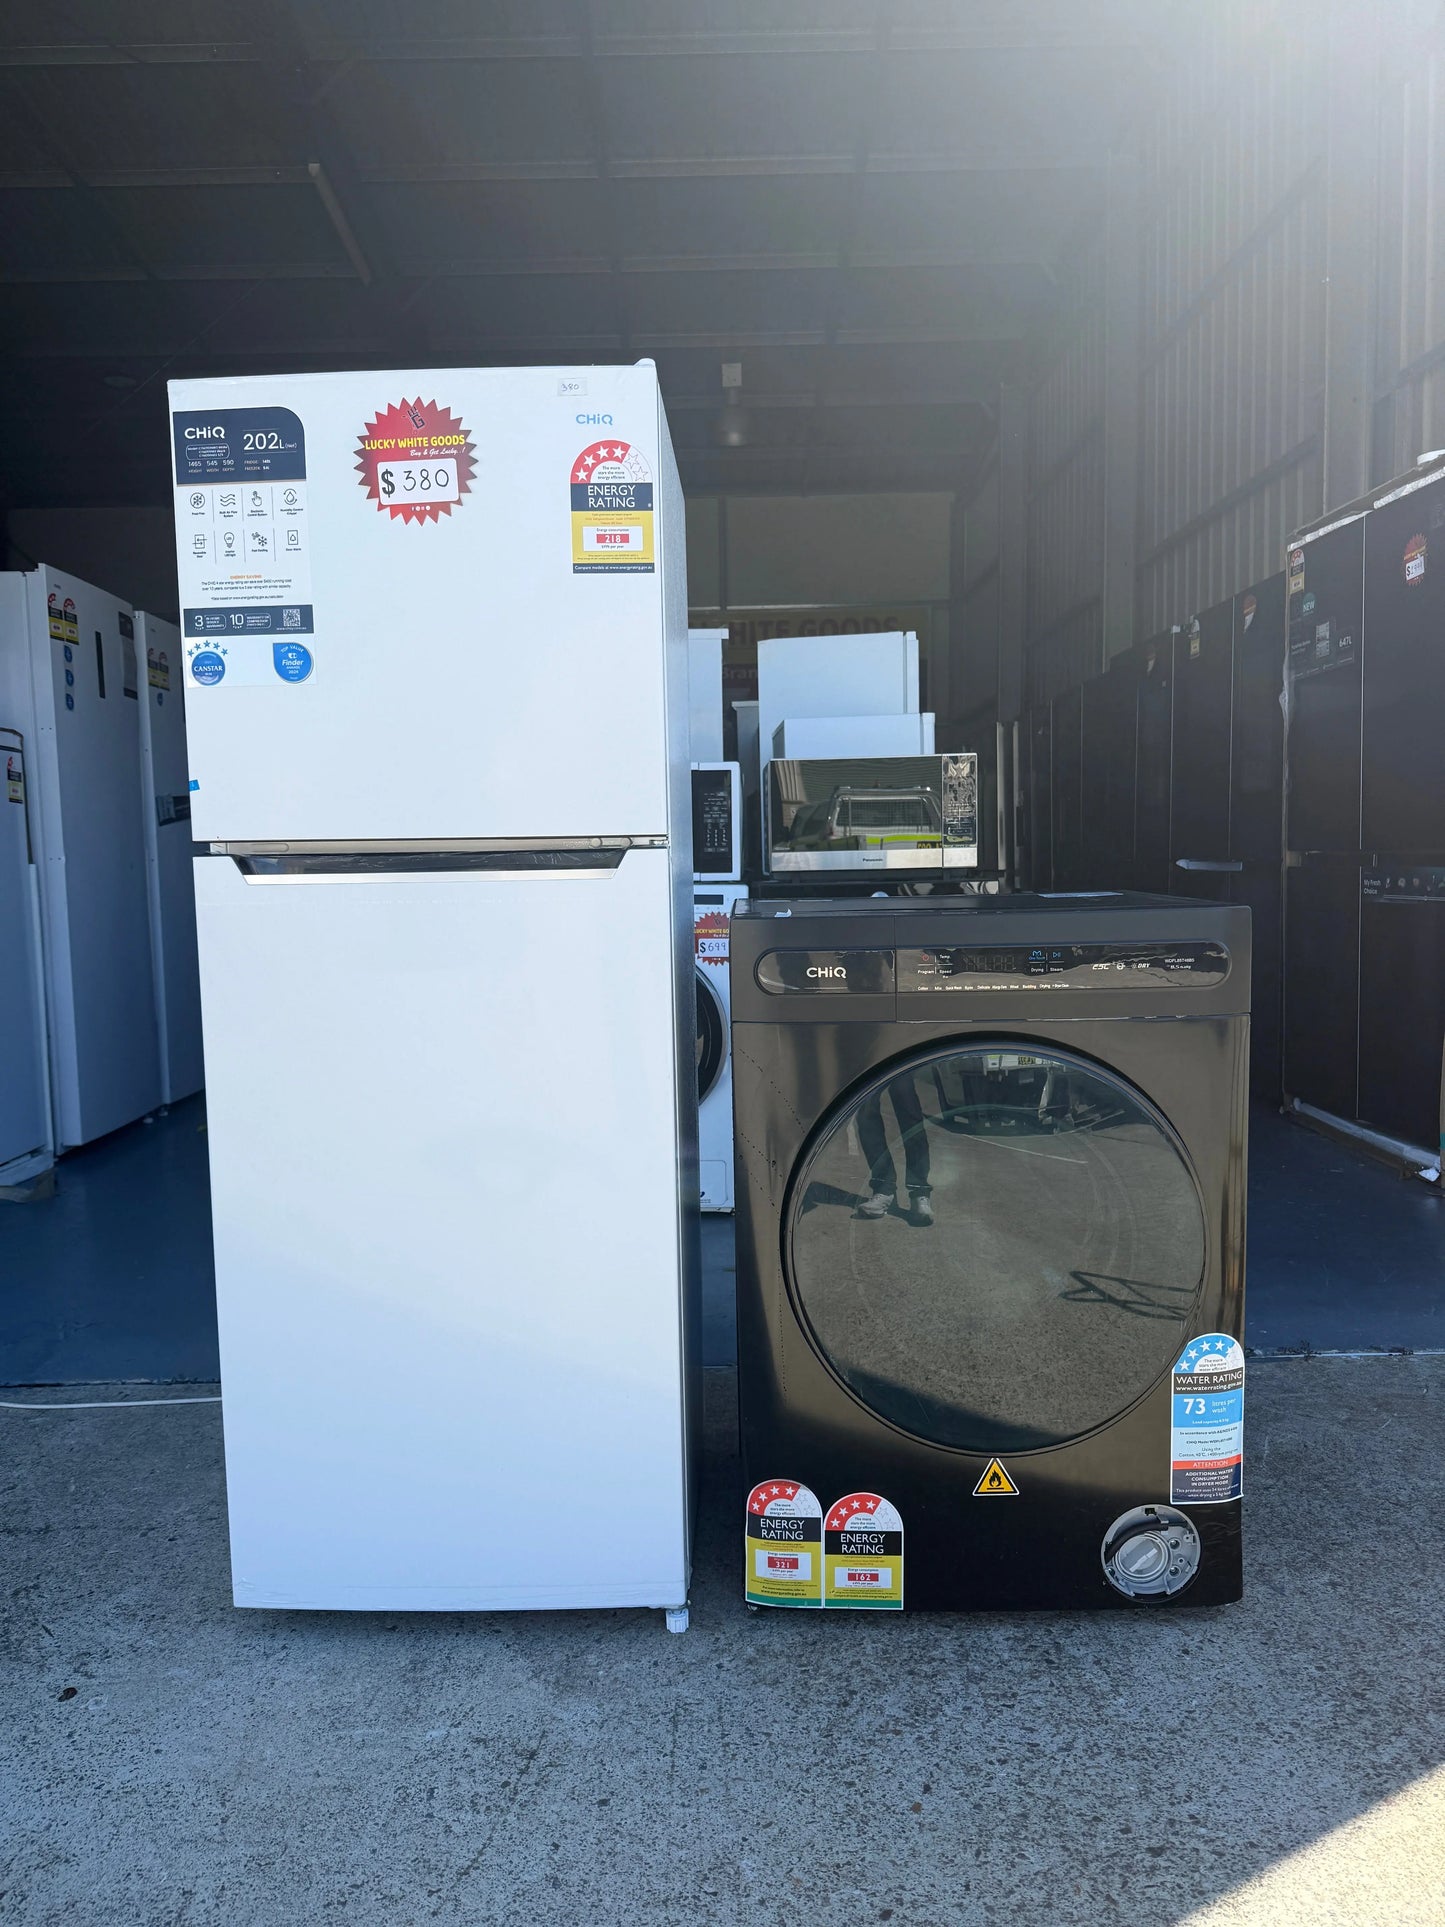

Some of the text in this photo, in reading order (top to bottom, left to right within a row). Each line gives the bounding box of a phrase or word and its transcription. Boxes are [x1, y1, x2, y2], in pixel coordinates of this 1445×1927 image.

[576, 414, 613, 426] CHiQ
[184, 426, 226, 440] CHiQ
[244, 432, 284, 451] 202L
[365, 435, 465, 450] LUCKY WHITE GOODS
[587, 485, 635, 496] ENERGY
[588, 497, 636, 508] RATING
[605, 534, 621, 543] 218
[195, 615, 203, 627] 3
[230, 613, 244, 626] 10
[282, 658, 304, 667] Finder
[806, 966, 847, 979] CHiQ
[1176, 1370, 1242, 1384] WATER RATING
[1183, 1398, 1206, 1415] 73
[1193, 1460, 1229, 1468] ATTENTION
[760, 1518, 804, 1530] ENERGY
[761, 1529, 804, 1540] RATING
[841, 1533, 886, 1543] ENERGY
[842, 1544, 885, 1554] RATING
[775, 1561, 790, 1569] 321
[855, 1573, 871, 1581] 162
